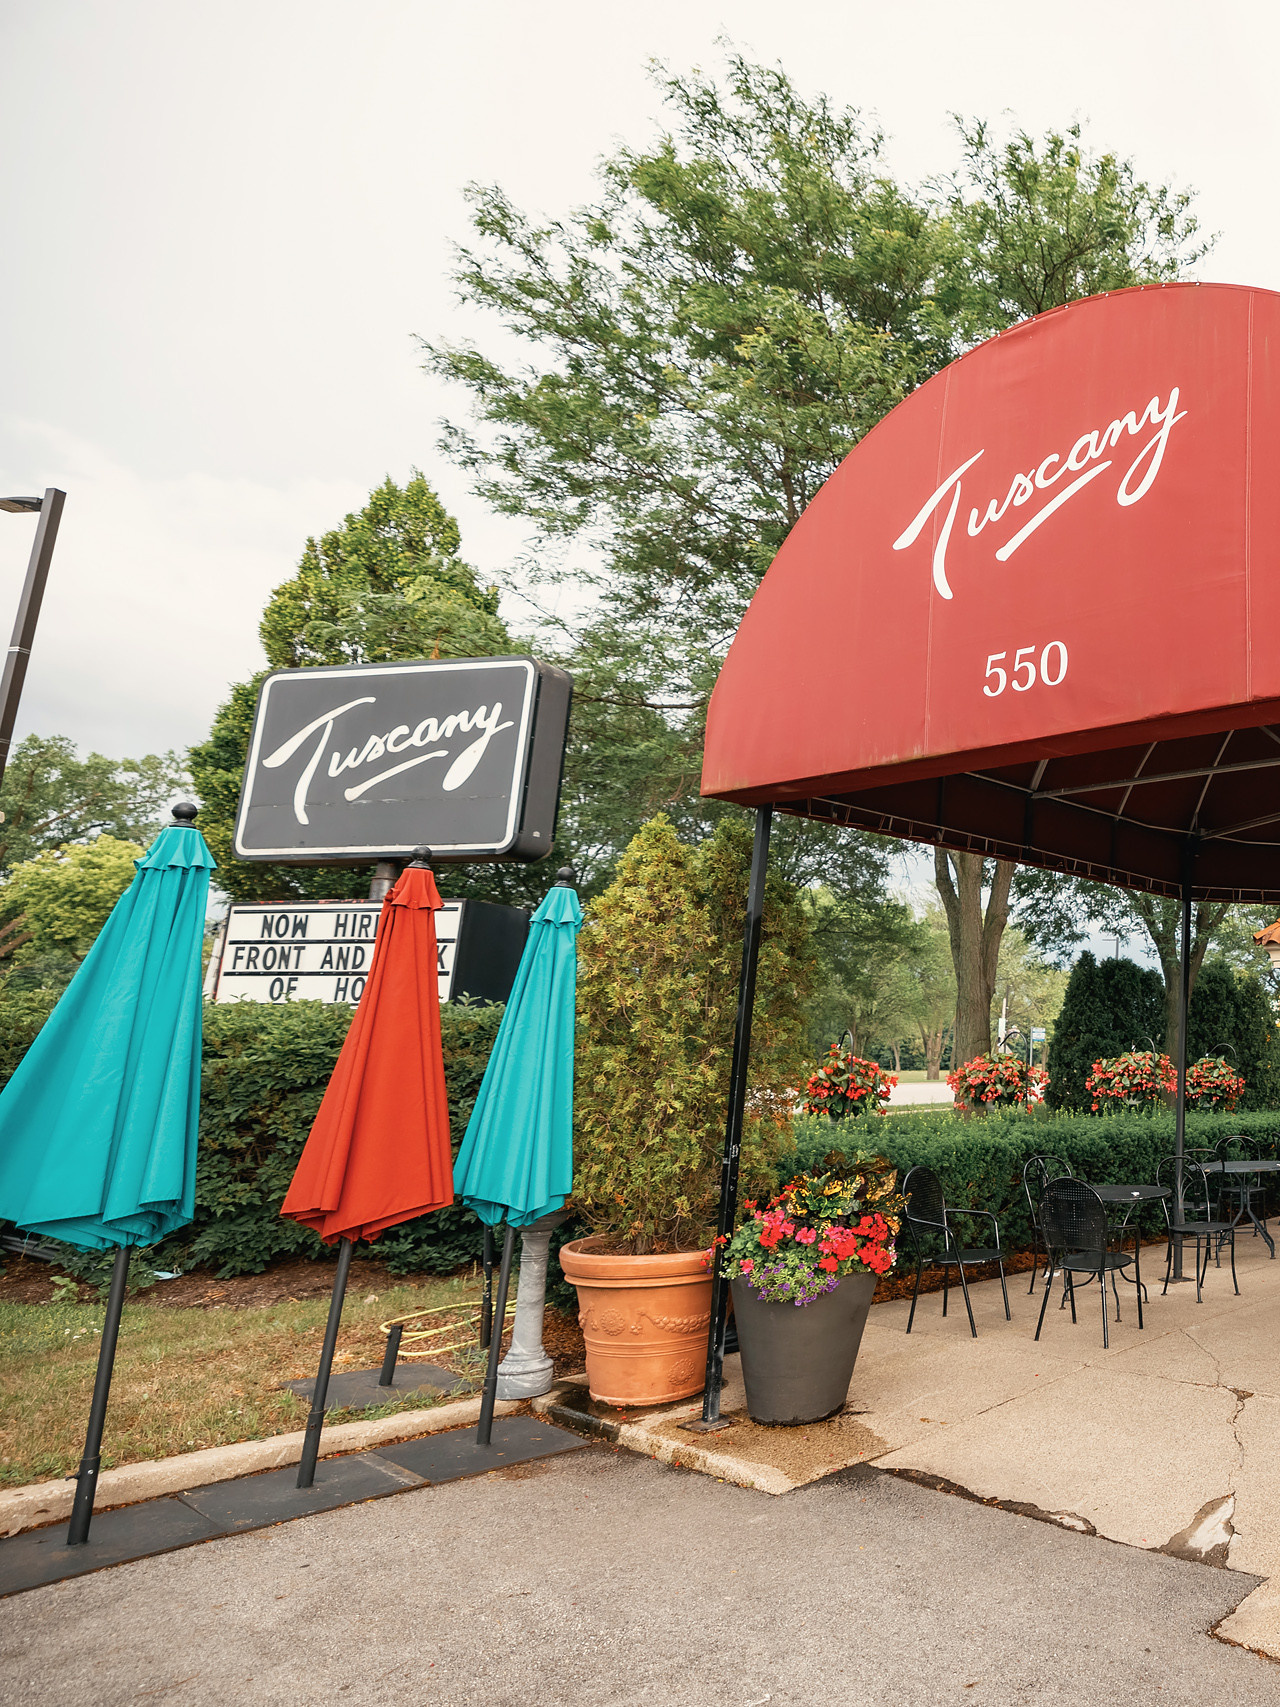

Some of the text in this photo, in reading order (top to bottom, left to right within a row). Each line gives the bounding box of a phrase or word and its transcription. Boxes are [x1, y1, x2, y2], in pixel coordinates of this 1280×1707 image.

[892, 386, 1188, 600] Tuscany
[982, 640, 1069, 697] 550
[262, 696, 515, 825] Tuscany
[260, 913, 380, 939] NOW HIRI
[231, 945, 366, 971] FRONT AND
[269, 977, 299, 1002] OF
